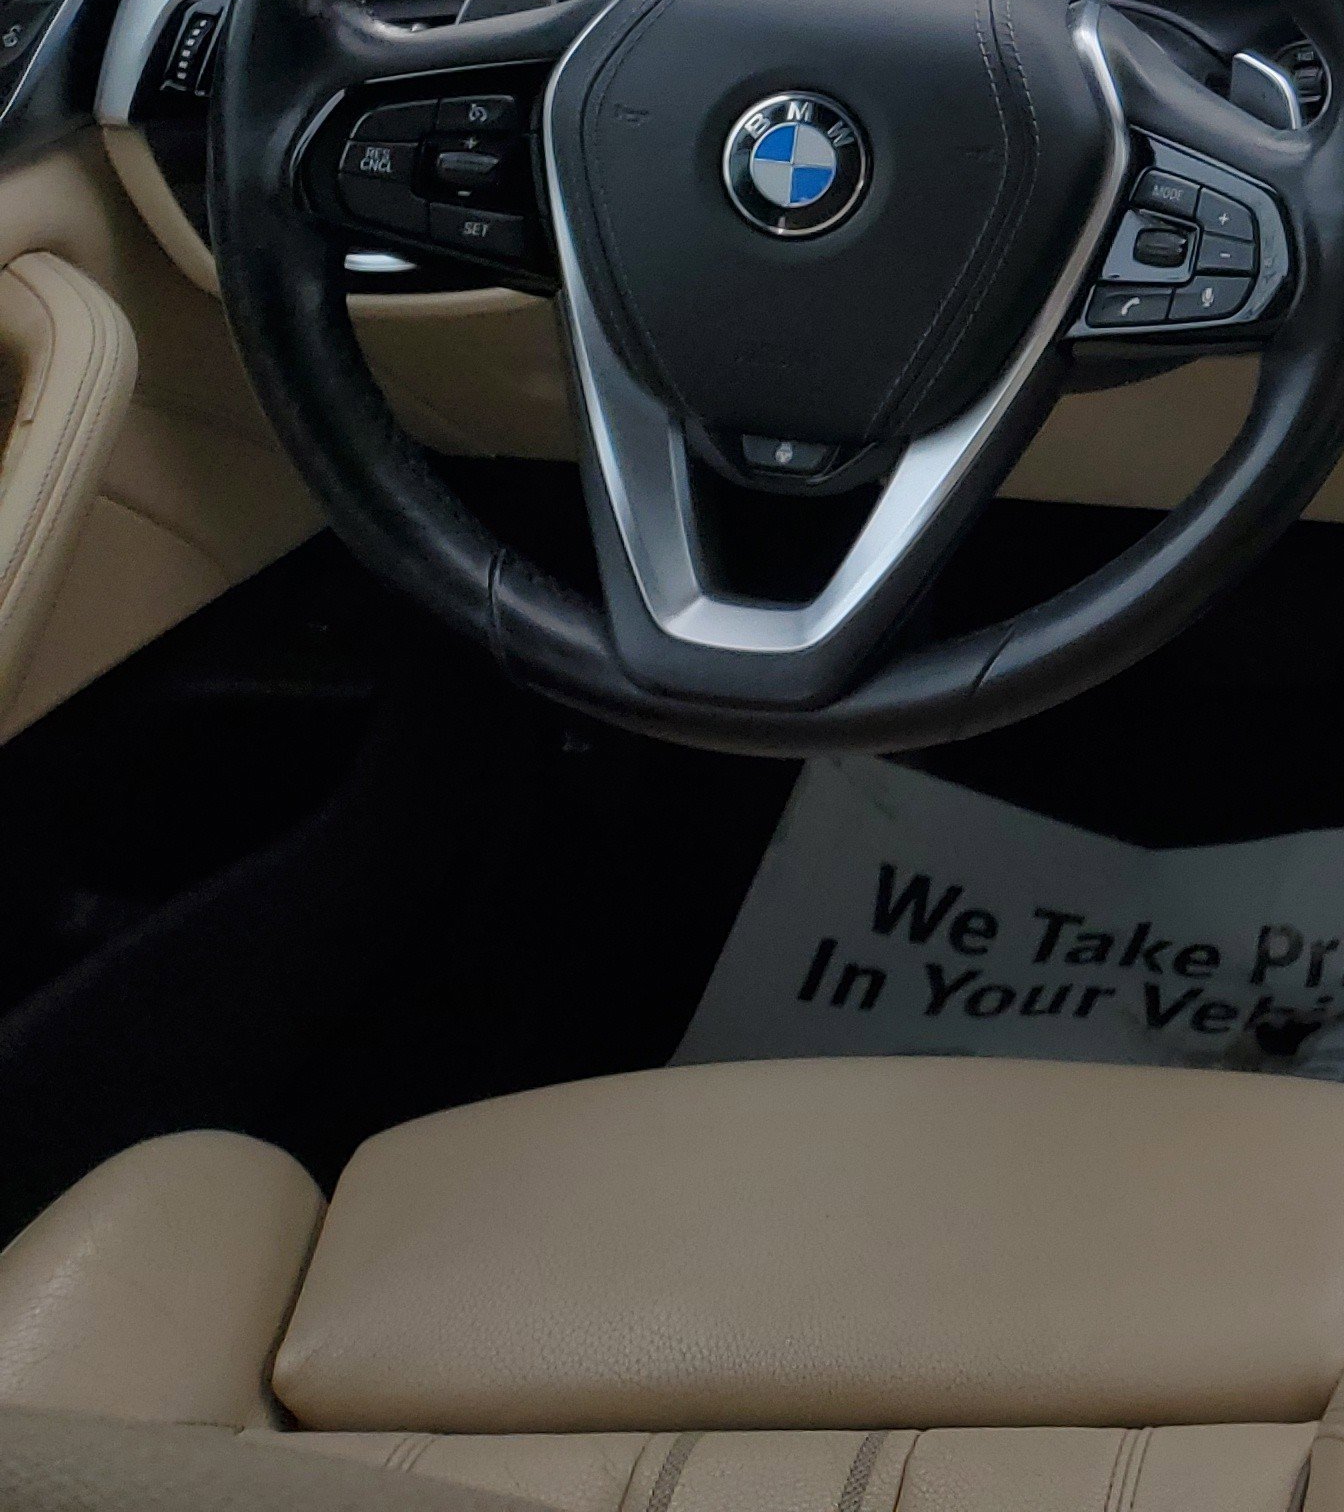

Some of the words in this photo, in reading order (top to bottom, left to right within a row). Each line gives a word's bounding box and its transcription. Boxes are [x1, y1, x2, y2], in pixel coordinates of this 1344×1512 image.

[744, 100, 856, 149] BMW
[463, 221, 489, 237] SET
[872, 861, 999, 957] We
[1032, 905, 1222, 980] Take
[798, 937, 888, 1012] In
[922, 961, 1117, 1020] Your
